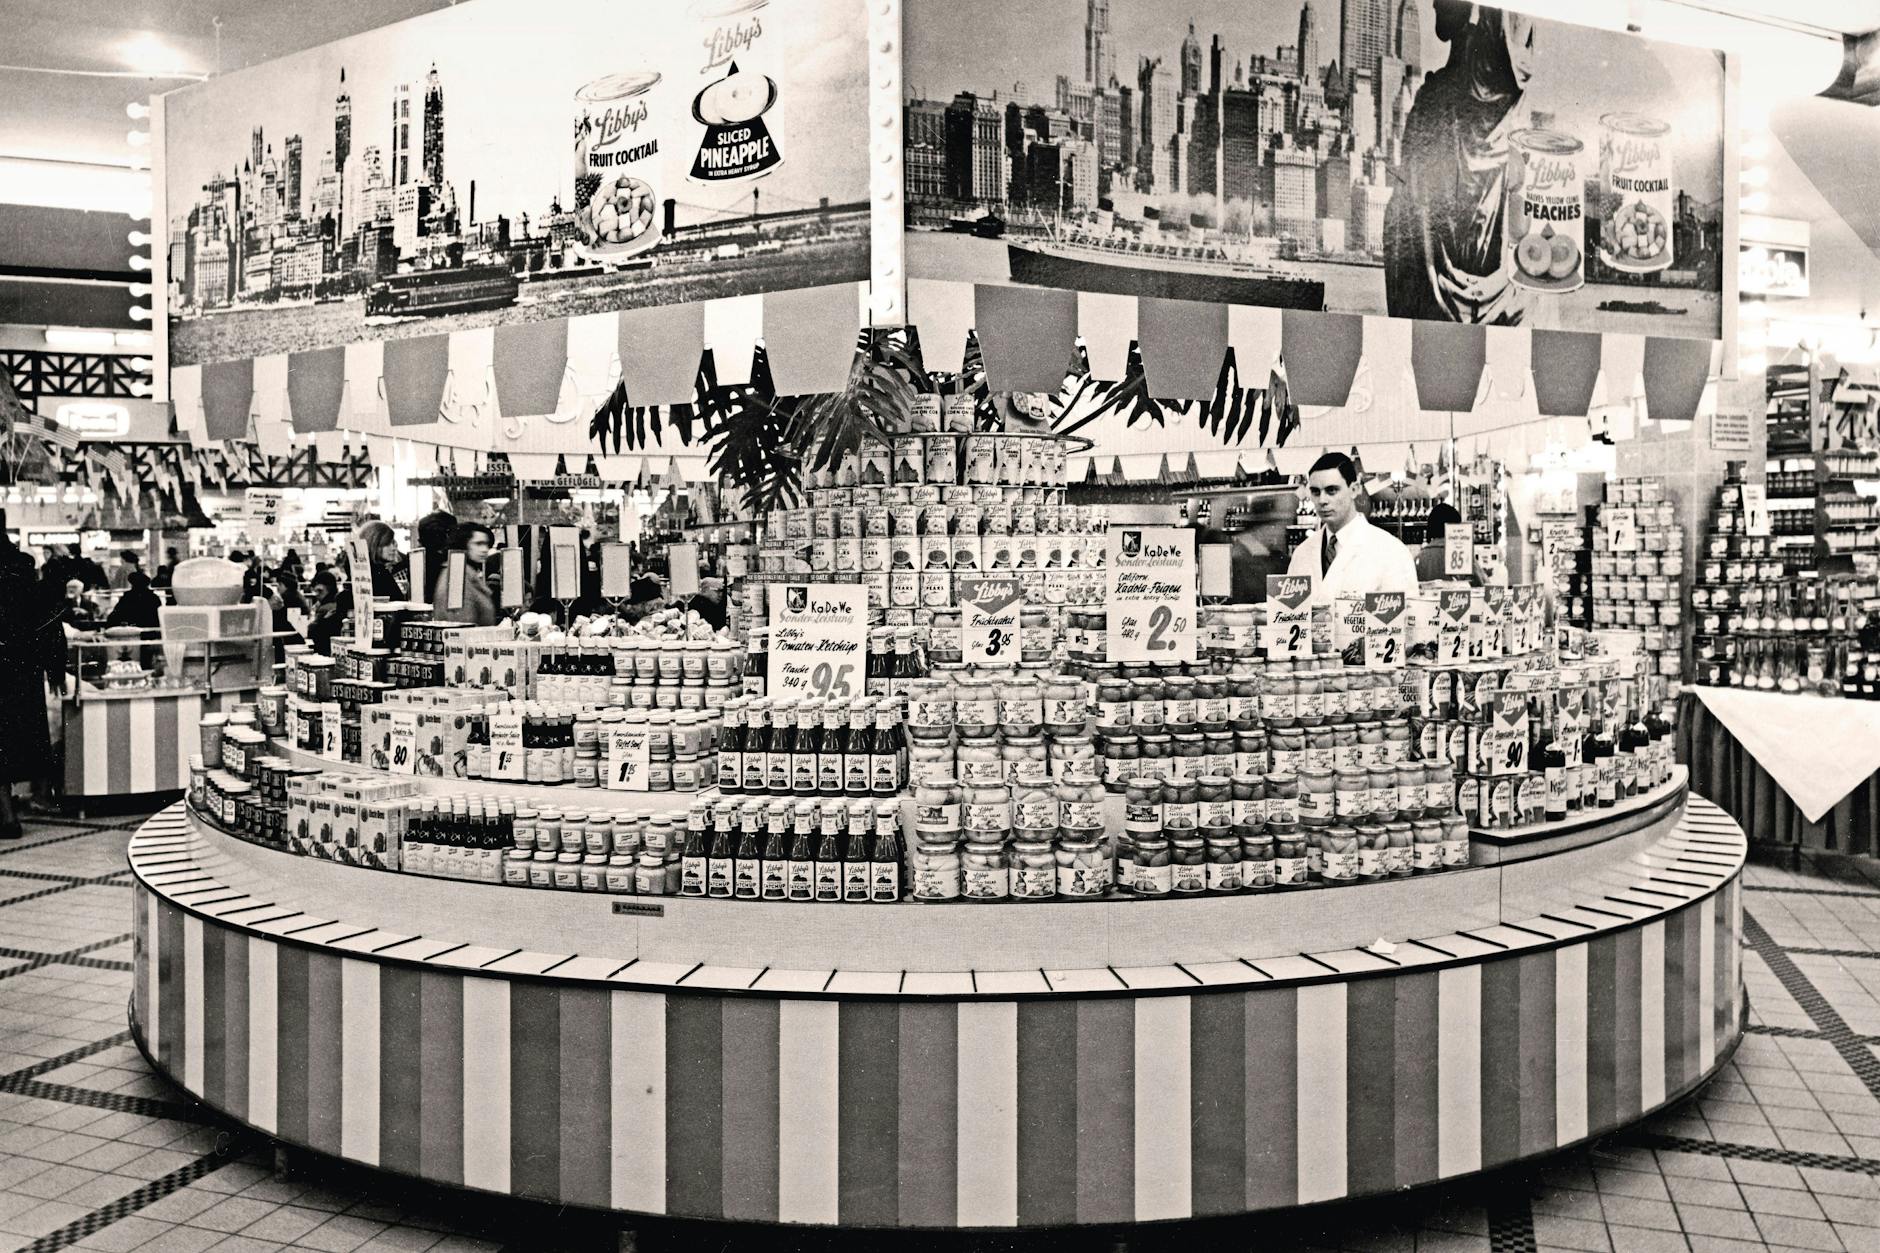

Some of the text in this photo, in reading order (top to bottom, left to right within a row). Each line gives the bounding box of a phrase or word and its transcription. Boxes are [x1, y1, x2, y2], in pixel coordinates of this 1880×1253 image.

[700, 17, 762, 75] Libby's
[591, 100, 648, 151] Libby's
[718, 128, 751, 145] SLICED
[589, 138, 658, 168] FRUIT COCKTAIL
[701, 136, 769, 168] PINEAPPLE
[1614, 141, 1661, 173] Libby's
[1526, 158, 1576, 191] Libby's
[1612, 175, 1668, 192] FRUIT COCKTAIL
[1524, 201, 1581, 221] PEACHES
[864, 439, 880, 449] Libby's
[896, 438, 914, 449] Libby's
[931, 437, 950, 449] Libby's
[975, 438, 992, 449] Libby's
[1001, 439, 1019, 450] Libby's
[558, 476, 597, 486] GEFLÜGEL
[828, 489, 847, 500] Libby's
[854, 489, 872, 501] Libby's
[883, 488, 900, 500] Libby's
[915, 488, 935, 500] Libby's
[950, 488, 969, 500] Libby's
[978, 488, 997, 499] Libby's
[1144, 545, 1181, 557] KaDeWe
[1450, 551, 1463, 569] 85
[896, 575, 912, 583] Libby's
[927, 574, 944, 583] Libby's
[1028, 574, 1042, 582] Libby's
[970, 581, 1013, 604] Libby's
[1275, 578, 1308, 600] Libby's
[811, 601, 852, 613] KaDeWe
[1370, 594, 1401, 614] Libby's
[1443, 592, 1468, 614] Libby's
[775, 628, 805, 640] Libby's
[782, 678, 800, 688] 340
[870, 680, 886, 690] Libby's
[1502, 695, 1525, 715] Libby's
[394, 745, 407, 766] 80
[720, 755, 735, 764] Libby's
[746, 755, 761, 765] Libby's
[1506, 741, 1522, 768] 90
[770, 756, 786, 765] Libby's
[795, 757, 811, 766] Libby's
[821, 758, 837, 766] Libby's
[848, 757, 865, 766] Libby's
[876, 758, 892, 766] Libby's
[684, 861, 700, 869] Libby's
[711, 862, 727, 871] Libby's
[737, 863, 754, 871] Libby's
[765, 864, 784, 873] Libby's
[791, 864, 809, 874] Libby's
[819, 865, 836, 875] Libby's
[849, 866, 866, 875] Libby's
[875, 866, 893, 875] Libby's
